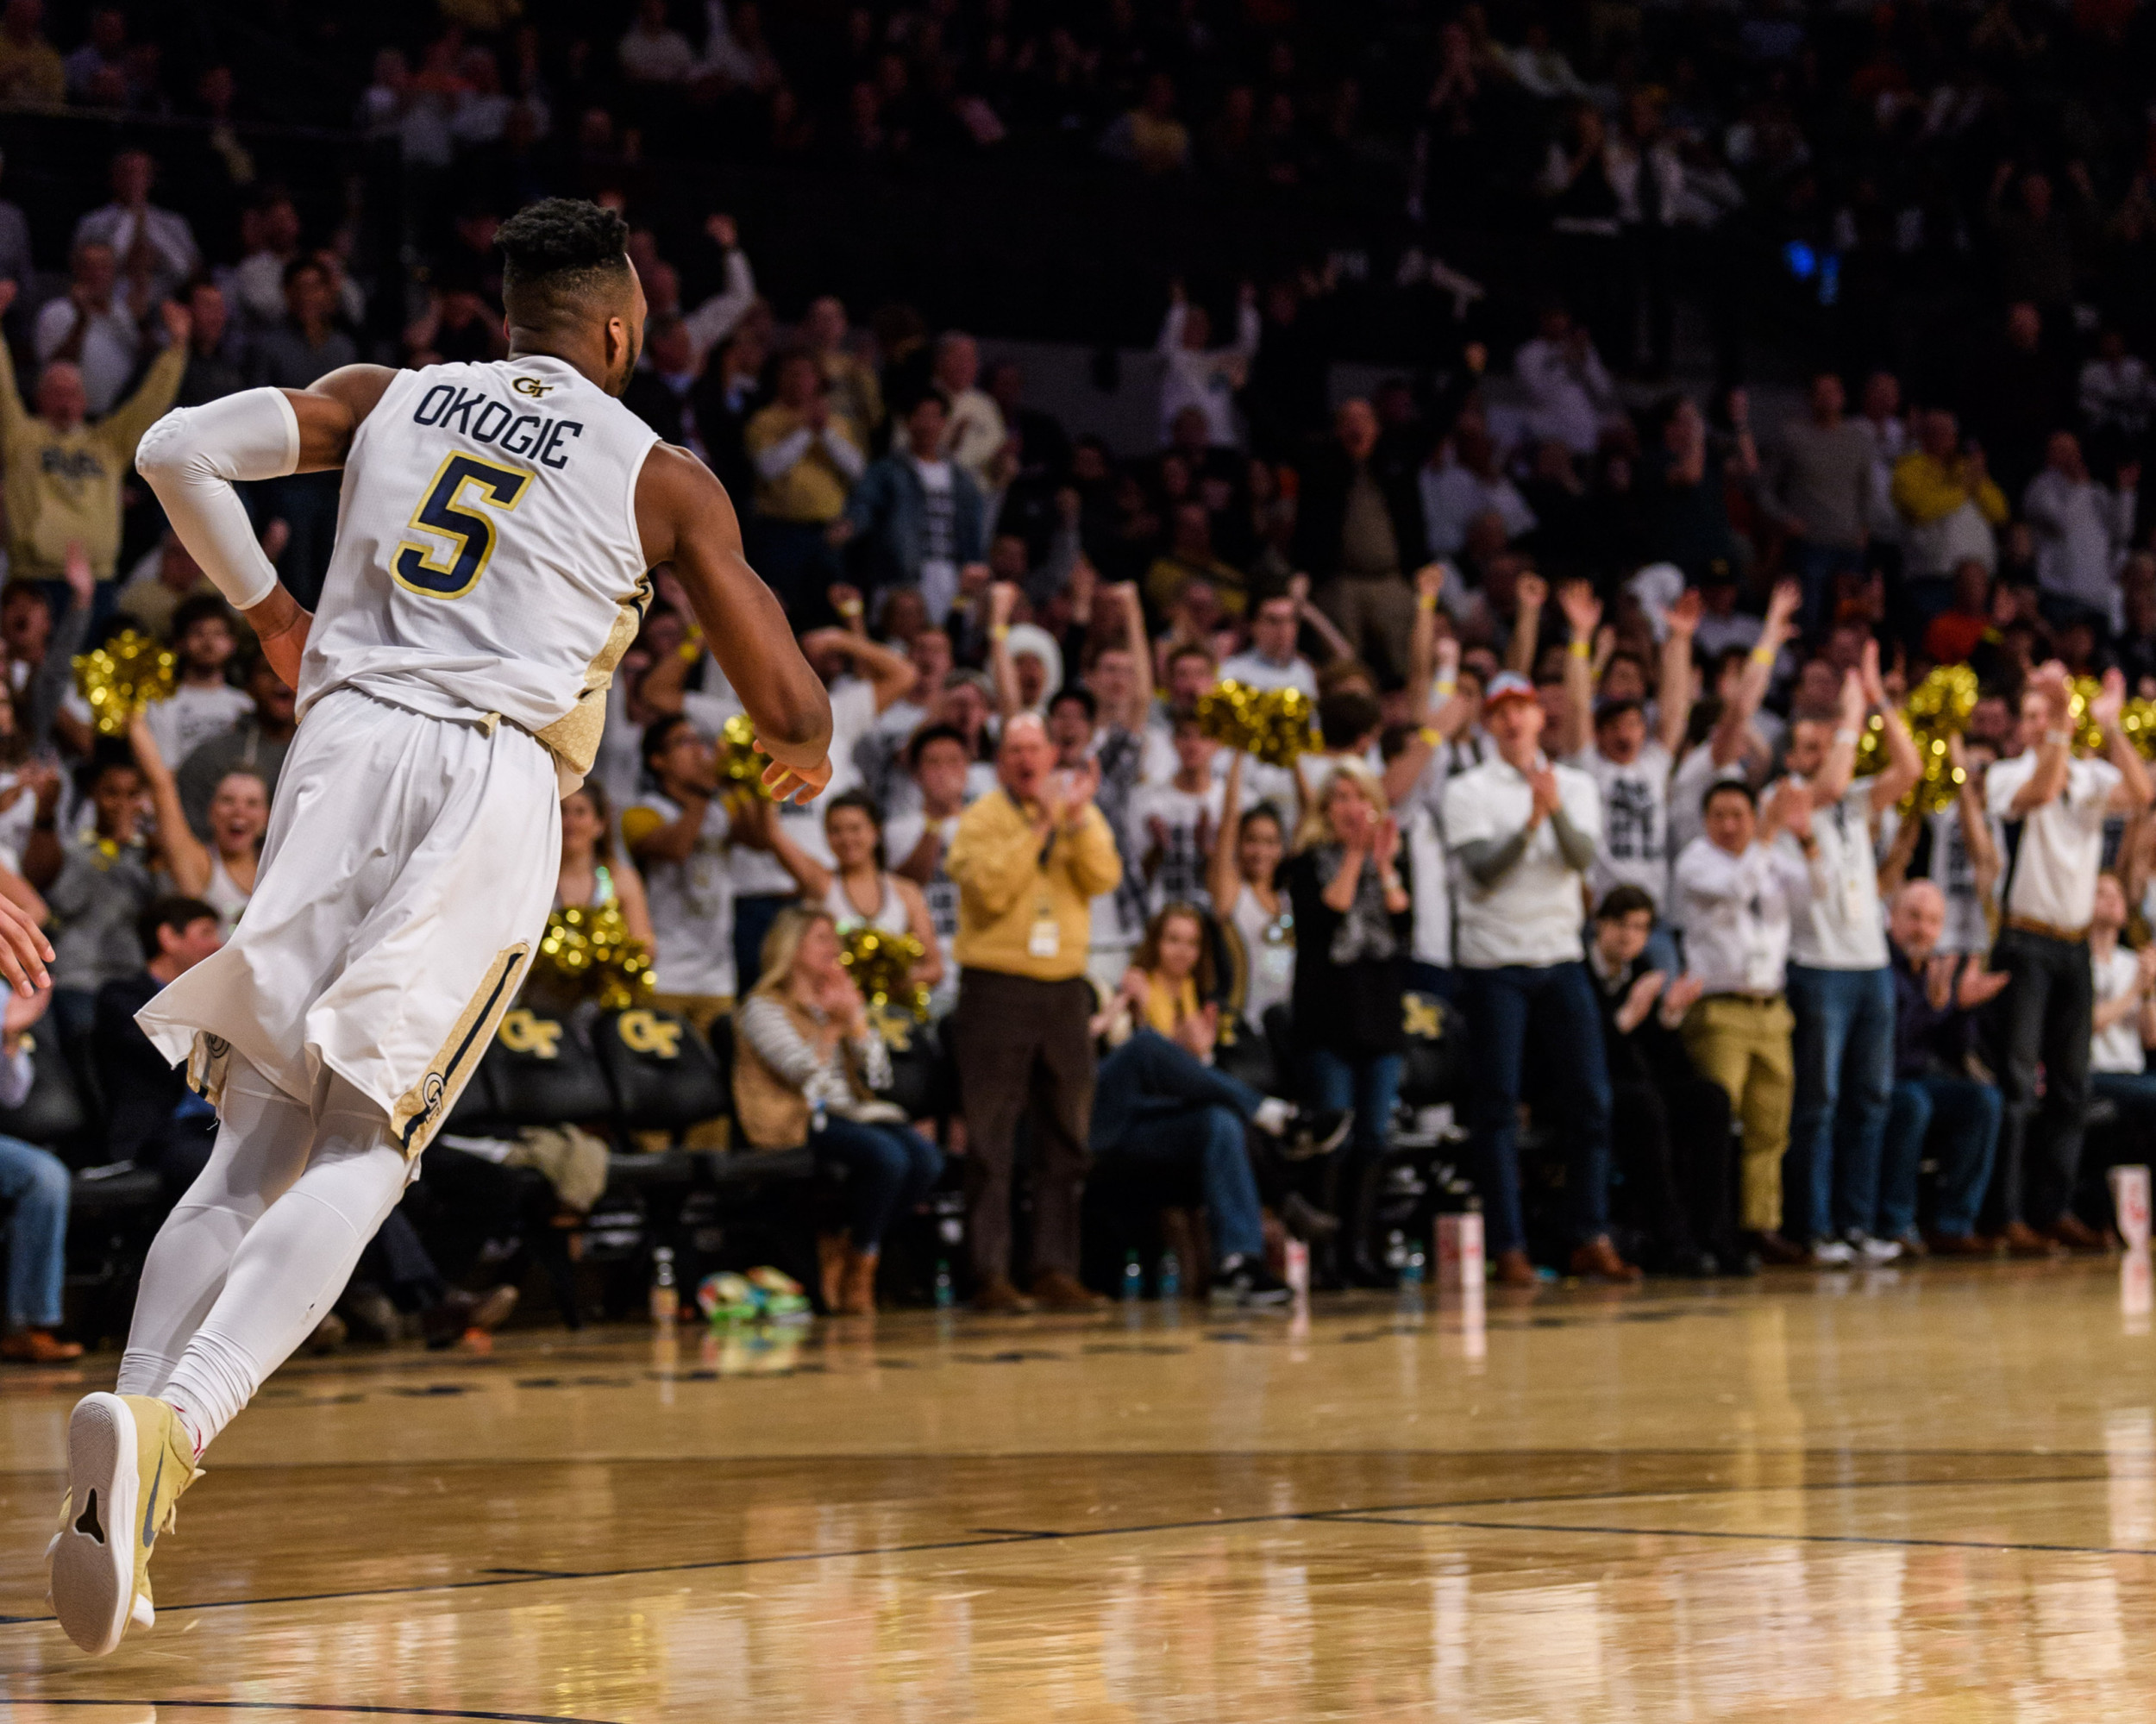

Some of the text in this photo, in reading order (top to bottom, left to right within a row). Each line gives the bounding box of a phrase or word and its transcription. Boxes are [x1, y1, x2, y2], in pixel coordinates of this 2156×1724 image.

[413, 385, 584, 469] OKOGIE
[511, 376, 554, 398] GT
[389, 449, 536, 600] 5
